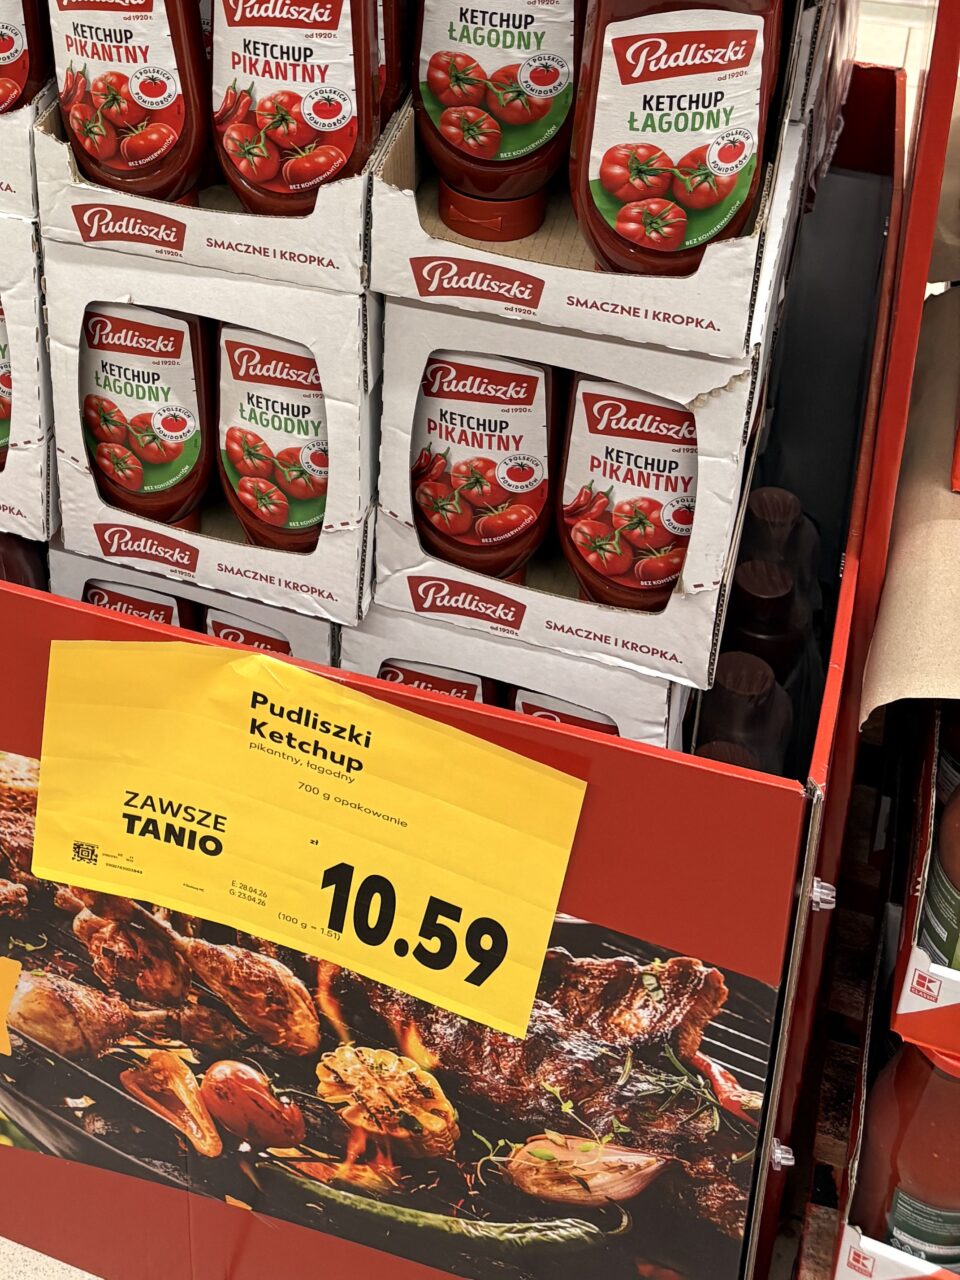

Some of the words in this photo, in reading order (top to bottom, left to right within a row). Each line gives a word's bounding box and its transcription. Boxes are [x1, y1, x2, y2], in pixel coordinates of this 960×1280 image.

[448, 21, 546, 51] ŁAGODNY
[459, 7, 535, 30] KETCHUP
[231, 51, 329, 83] PIKANTNY
[242, 38, 313, 62] KETCHUP
[625, 38, 746, 78] Pudliszki
[628, 106, 735, 133] ŁAGODNY
[642, 90, 725, 112] KETCHUP
[422, 260, 534, 300] Pudliszki
[566, 295, 641, 318] SMACZNE
[644, 307, 649, 319] I
[652, 310, 720, 332] KROPKA.
[88, 316, 175, 353] Pudliszki
[94, 371, 171, 402] ŁAGODNY
[100, 360, 161, 385] KETCHUP
[425, 363, 528, 400] Pudliszki
[427, 417, 524, 452] PIKANTNY
[439, 408, 509, 433] KETCHUP
[104, 527, 191, 566] Pudliszki
[417, 580, 516, 622] Pudliszki
[545, 620, 611, 644] SMACZNE
[615, 637, 619, 647] I
[621, 639, 683, 665] KROPKA.
[250, 690, 372, 749] Pudliszki
[249, 717, 364, 773] Ketchup
[249, 741, 303, 767] pikantny,
[306, 759, 356, 784] łagodny
[123, 790, 228, 833] ZAWSZE
[297, 781, 320, 796] 700
[323, 790, 331, 801] g
[333, 794, 409, 828] opakowanie
[122, 812, 224, 857] TANIO
[309, 839, 319, 847] zł
[238, 891, 266, 907] 23.04.26
[239, 882, 268, 898] 28.04.26
[278, 912, 298, 925] (100
[320, 927, 341, 941] 1.51)
[320, 861, 510, 988] 10.59
